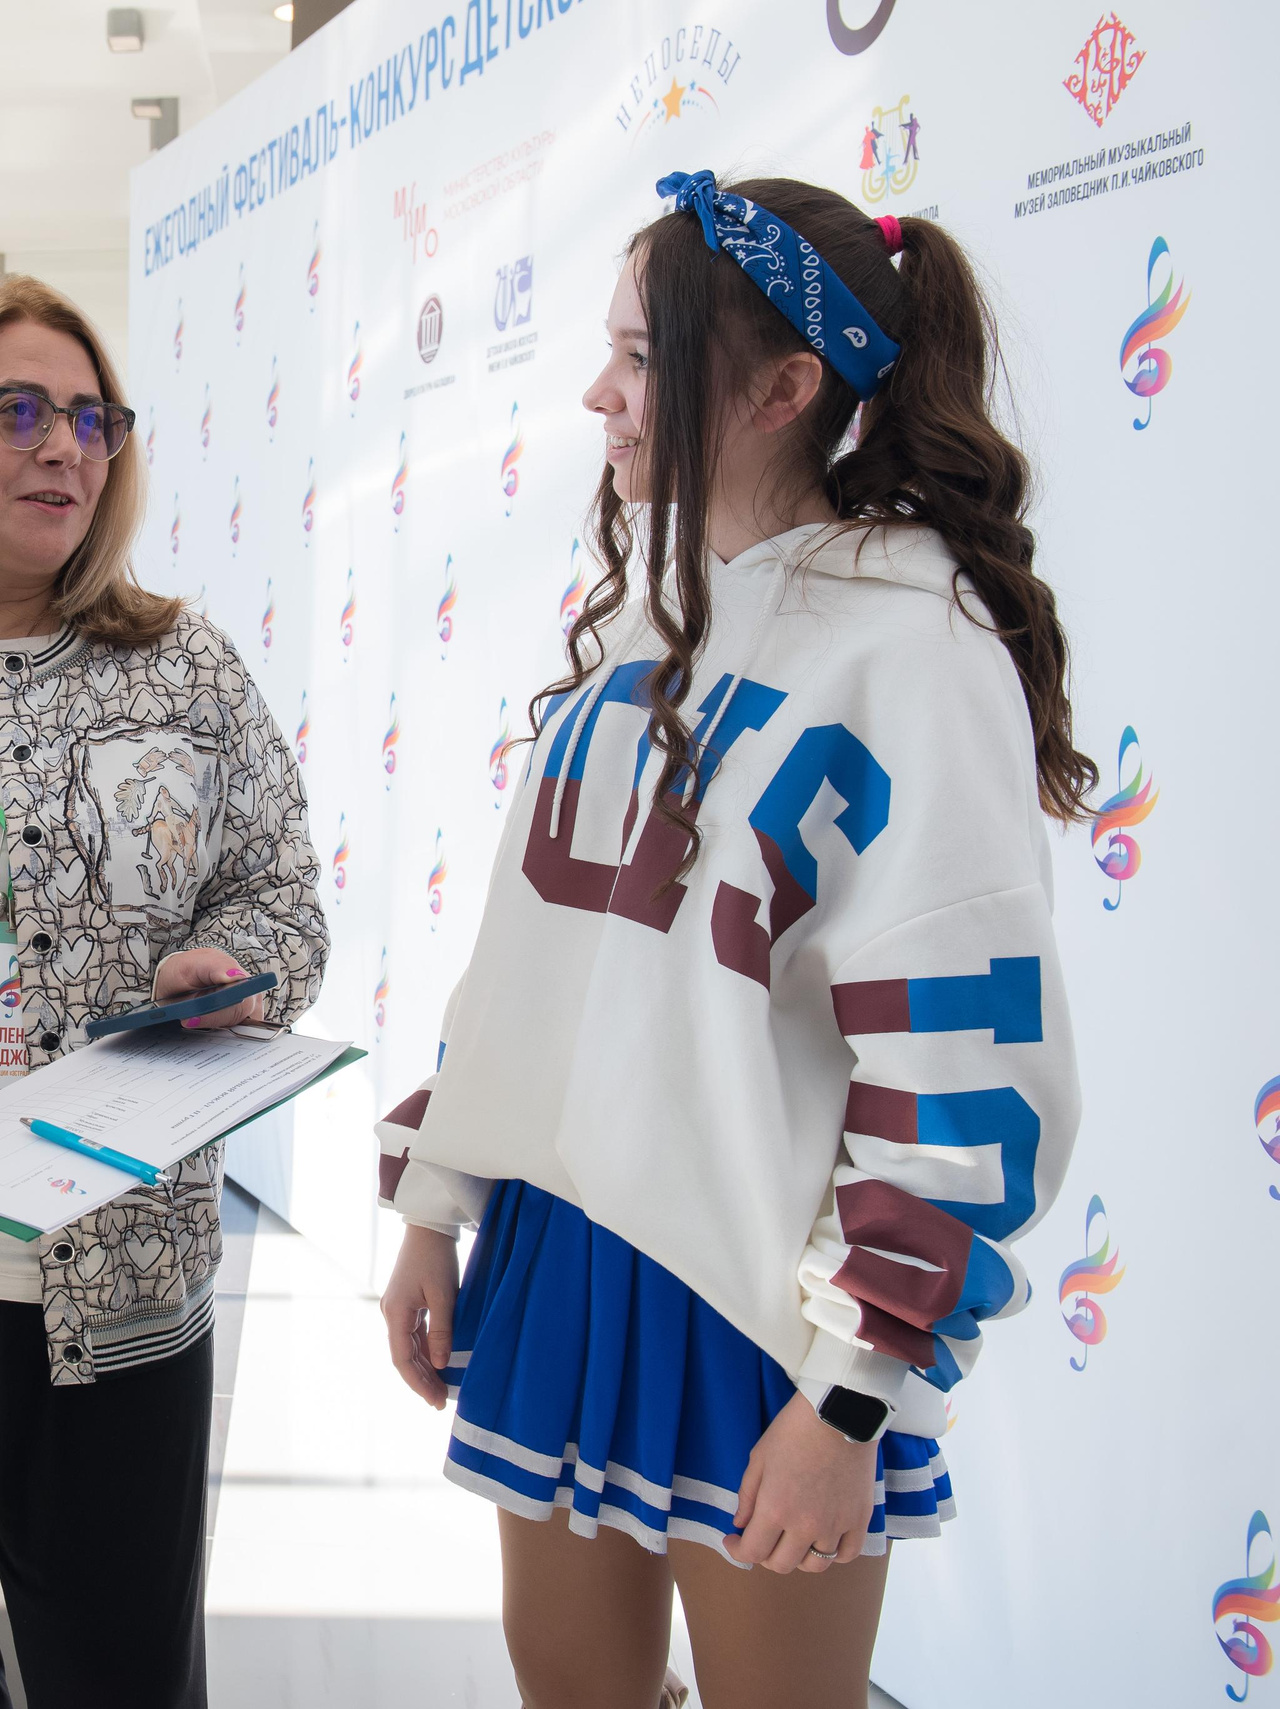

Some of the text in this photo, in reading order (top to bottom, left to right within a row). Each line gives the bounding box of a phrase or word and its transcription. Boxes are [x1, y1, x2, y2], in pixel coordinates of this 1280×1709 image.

[615, 25, 742, 131] НЕПОСЕДЫ
[1014, 192, 1046, 219] МУЗЕЙ
[1047, 175, 1110, 210] ЗАПОВЕДНИК
[1027, 121, 1192, 190] МЕМОРИАЛЬНЫЙ МУЗЫКАЛЬНЫЙ
[144, 164, 229, 278] ЕЖЕГОДНЫЙ
